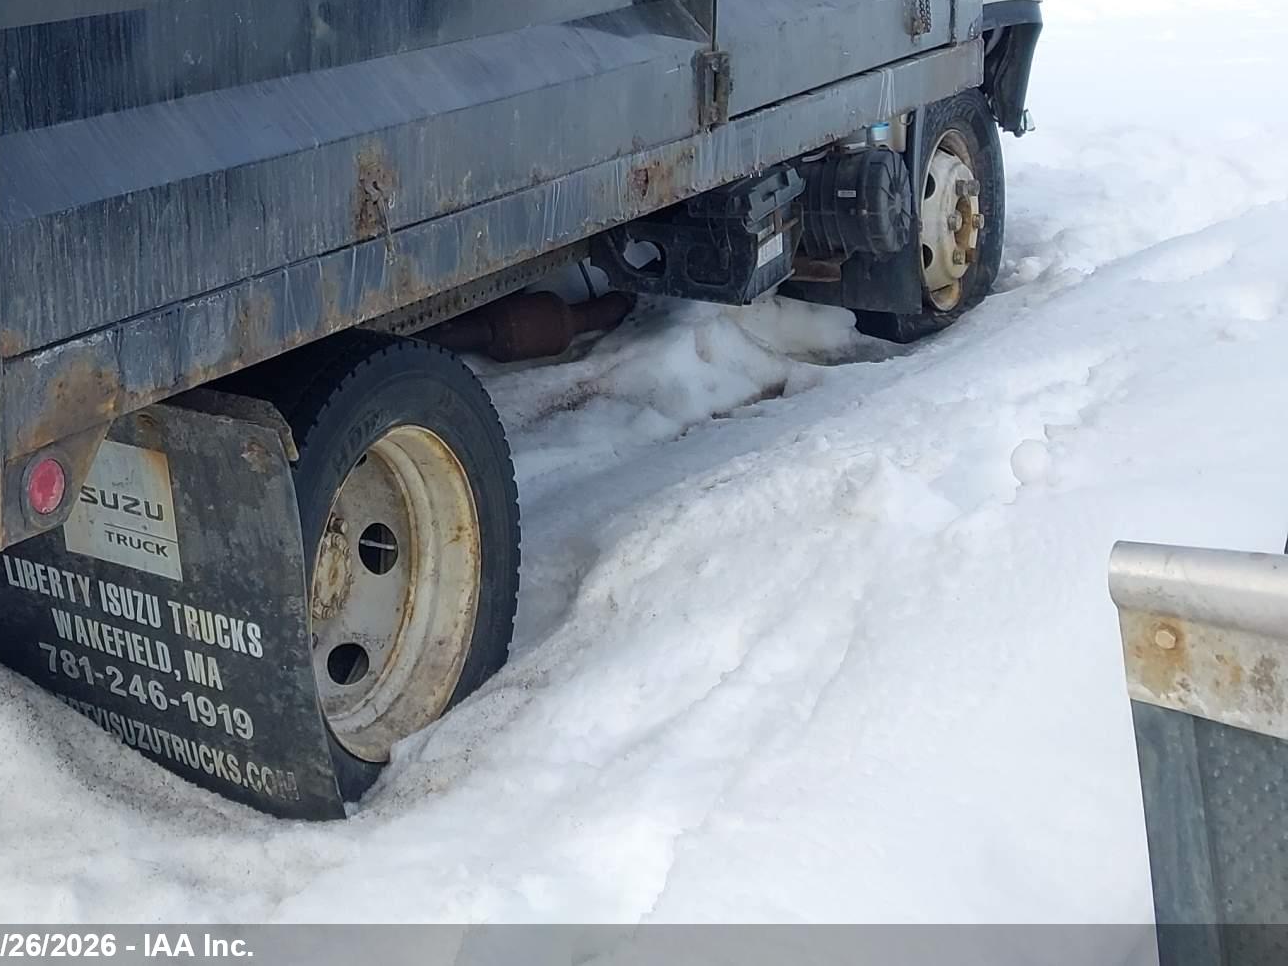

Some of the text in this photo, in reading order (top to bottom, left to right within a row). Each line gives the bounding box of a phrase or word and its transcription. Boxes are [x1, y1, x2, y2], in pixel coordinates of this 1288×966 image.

[104, 530, 168, 558] TRUCK
[2, 554, 264, 659] LIBERTY ISUZU TRUCKS
[51, 607, 224, 691] WAKEFIELD, MA
[38, 641, 255, 740] 781-246-1919
